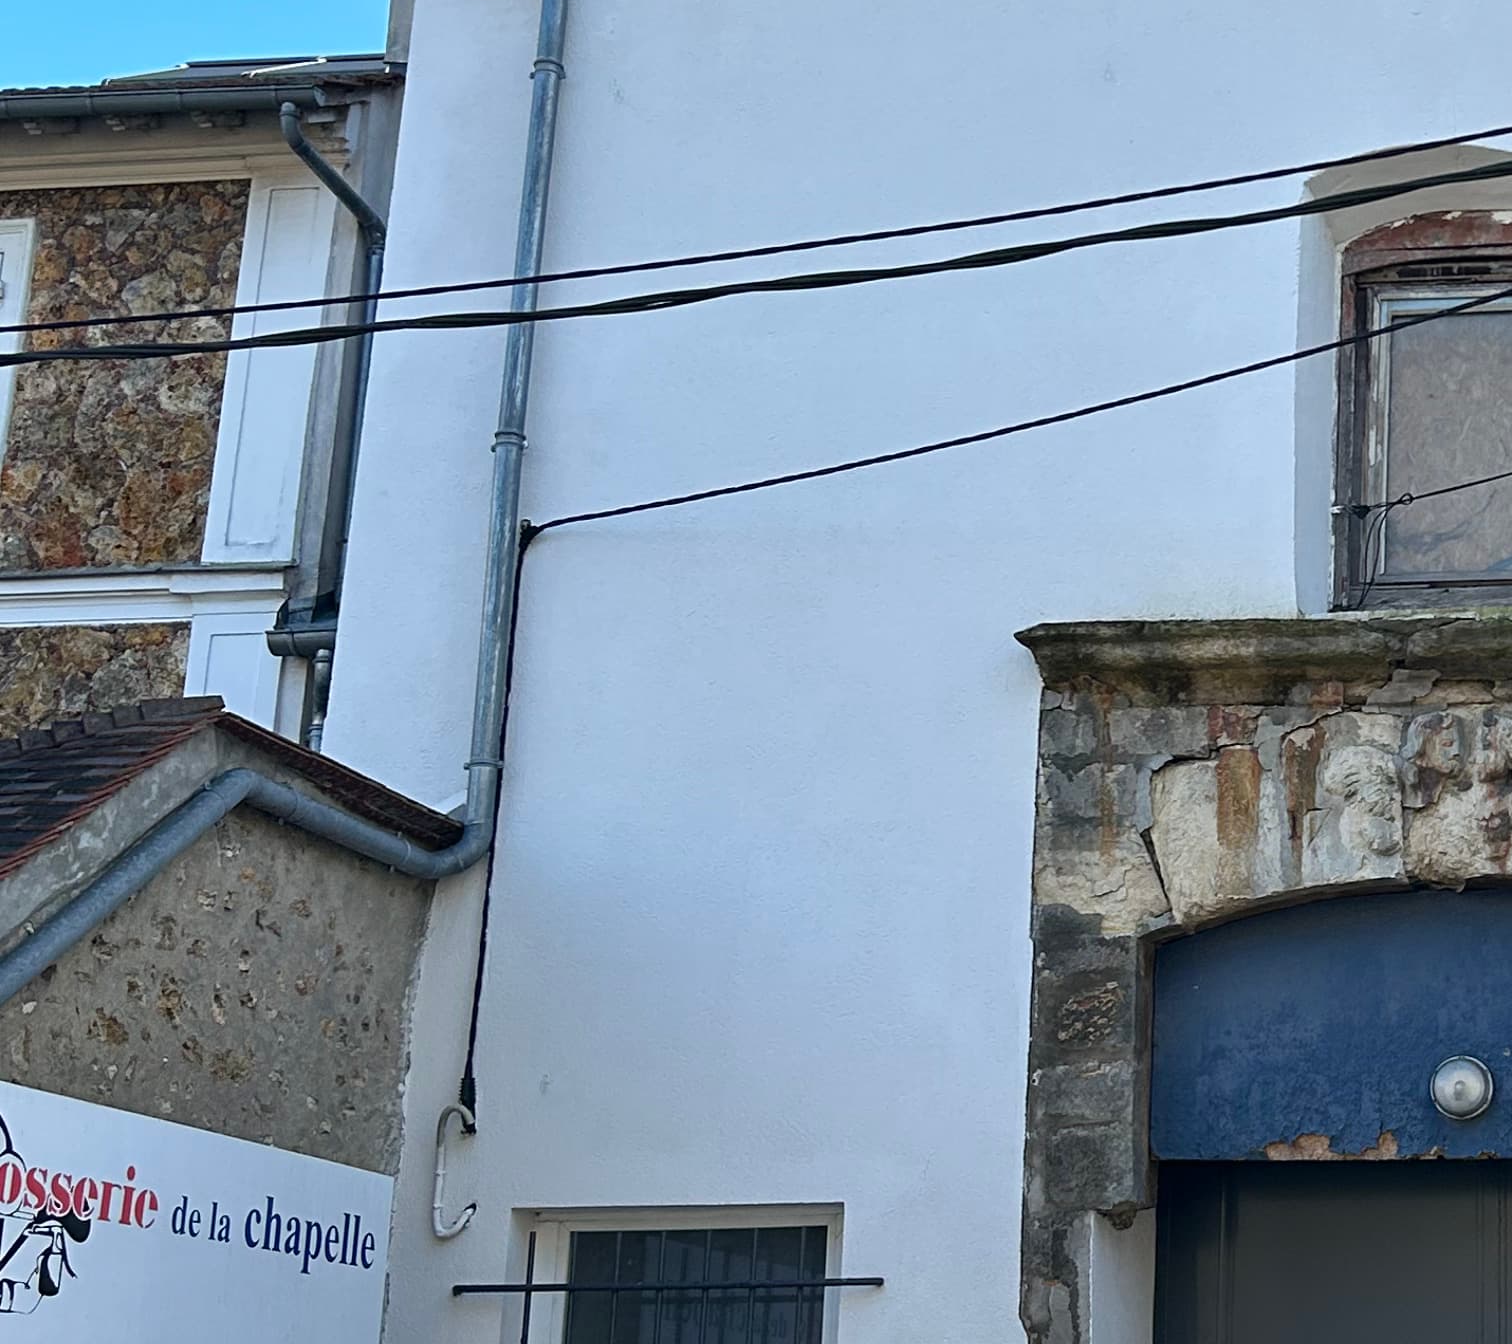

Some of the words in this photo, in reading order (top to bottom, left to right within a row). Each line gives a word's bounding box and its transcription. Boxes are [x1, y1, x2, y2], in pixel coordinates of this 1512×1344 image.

[171, 1194, 201, 1238] de
[207, 1201, 232, 1244] la
[244, 1195, 376, 1275] chapelle
